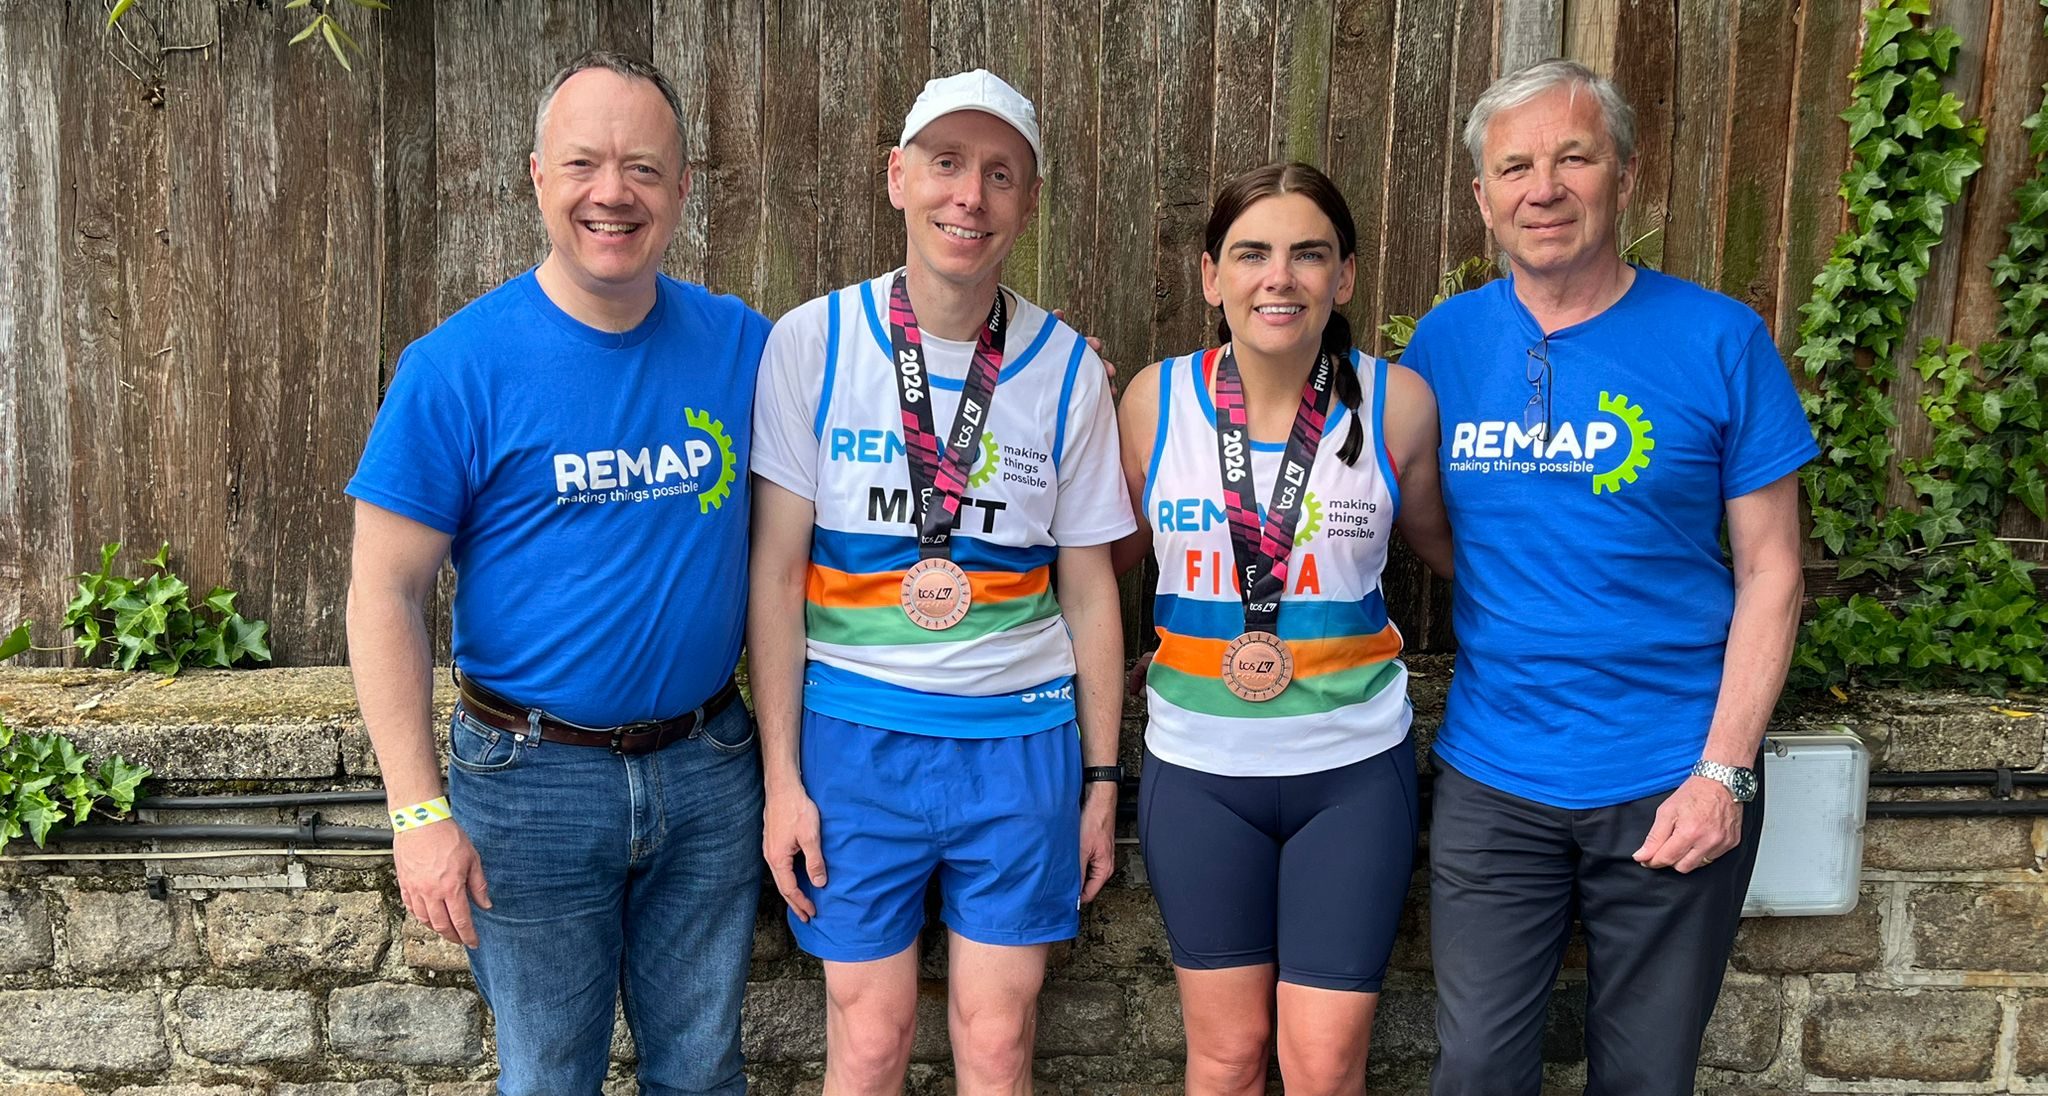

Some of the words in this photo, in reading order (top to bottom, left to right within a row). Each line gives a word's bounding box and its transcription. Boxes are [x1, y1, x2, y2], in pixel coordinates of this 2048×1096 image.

[899, 348, 924, 403] 2026
[954, 424, 974, 449] tcs
[1451, 421, 1617, 460] REMAP
[1004, 445, 1048, 463] making
[1222, 430, 1247, 482] 2026
[553, 439, 713, 493] REMAP
[1004, 457, 1039, 475] things
[1449, 459, 1490, 474] making
[1493, 459, 1536, 474] things
[1539, 460, 1594, 474] possible
[1003, 472, 1048, 489] possible
[556, 491, 606, 506] making
[610, 489, 650, 503] things
[652, 481, 699, 499] possible
[1277, 486, 1298, 510] tcs
[867, 486, 1007, 534] MTT
[1330, 499, 1376, 513] making
[1329, 512, 1368, 526] things
[1328, 527, 1375, 539] possible
[1186, 550, 1321, 596] FIA
[918, 588, 935, 599] tcs
[1249, 602, 1262, 611] tcs
[1239, 660, 1256, 671] tcs
